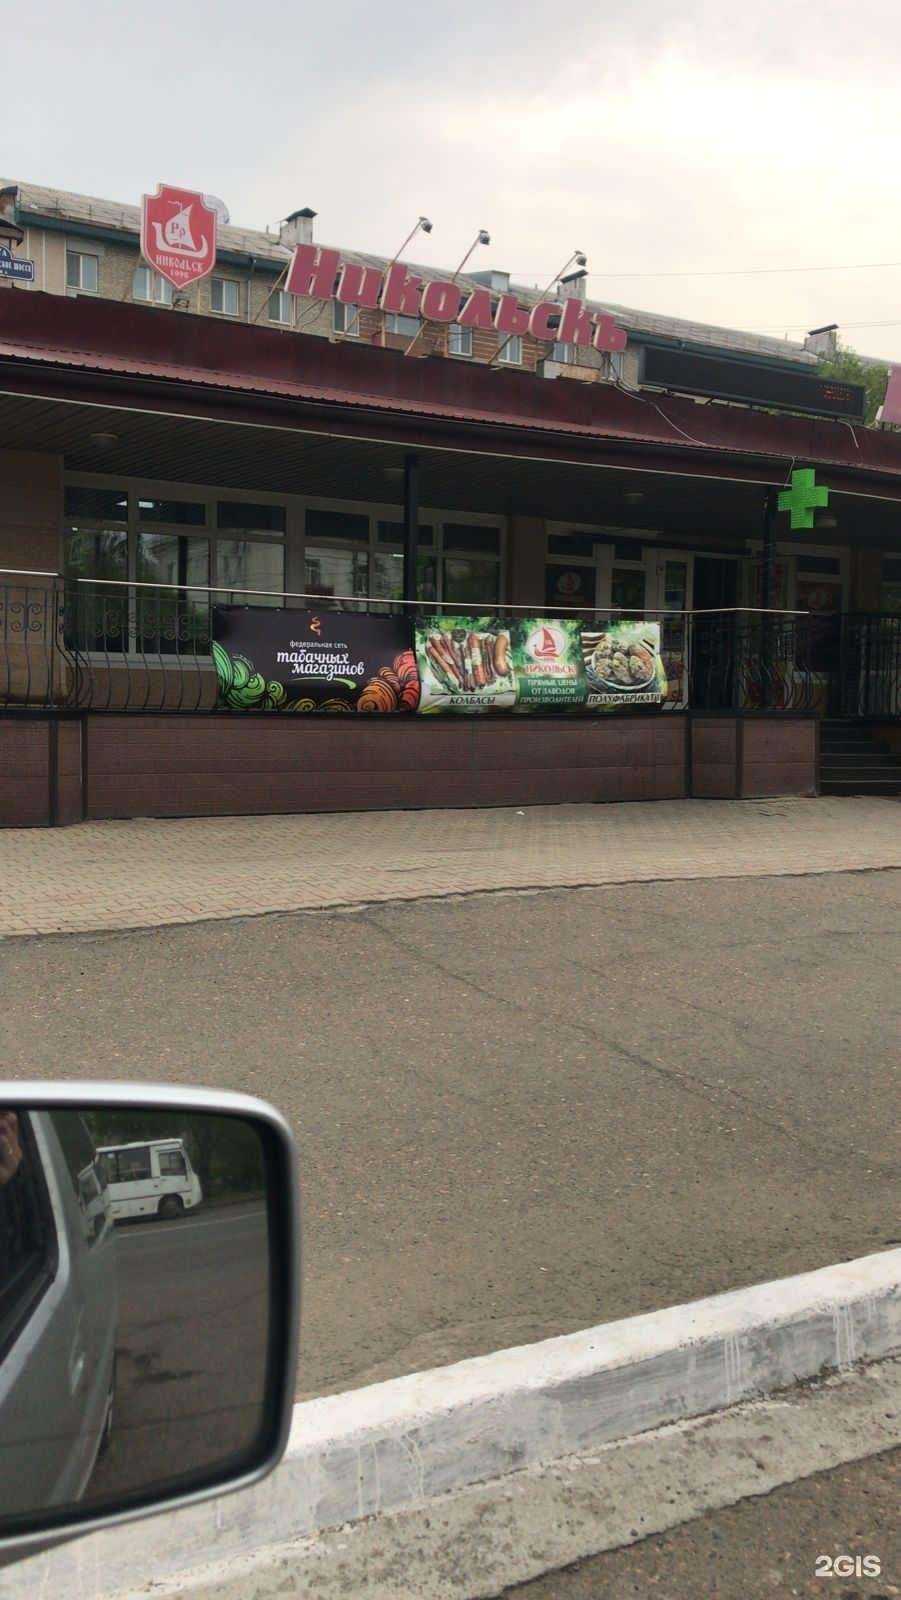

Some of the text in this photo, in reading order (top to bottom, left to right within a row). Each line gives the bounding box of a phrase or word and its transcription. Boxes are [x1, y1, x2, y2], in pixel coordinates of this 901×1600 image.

[290, 640, 332, 648] федеральная
[277, 649, 350, 664] табачных
[291, 661, 365, 681] магазинов
[531, 687, 542, 695] ОТ
[449, 696, 496, 705] КОЛБАСЫ
